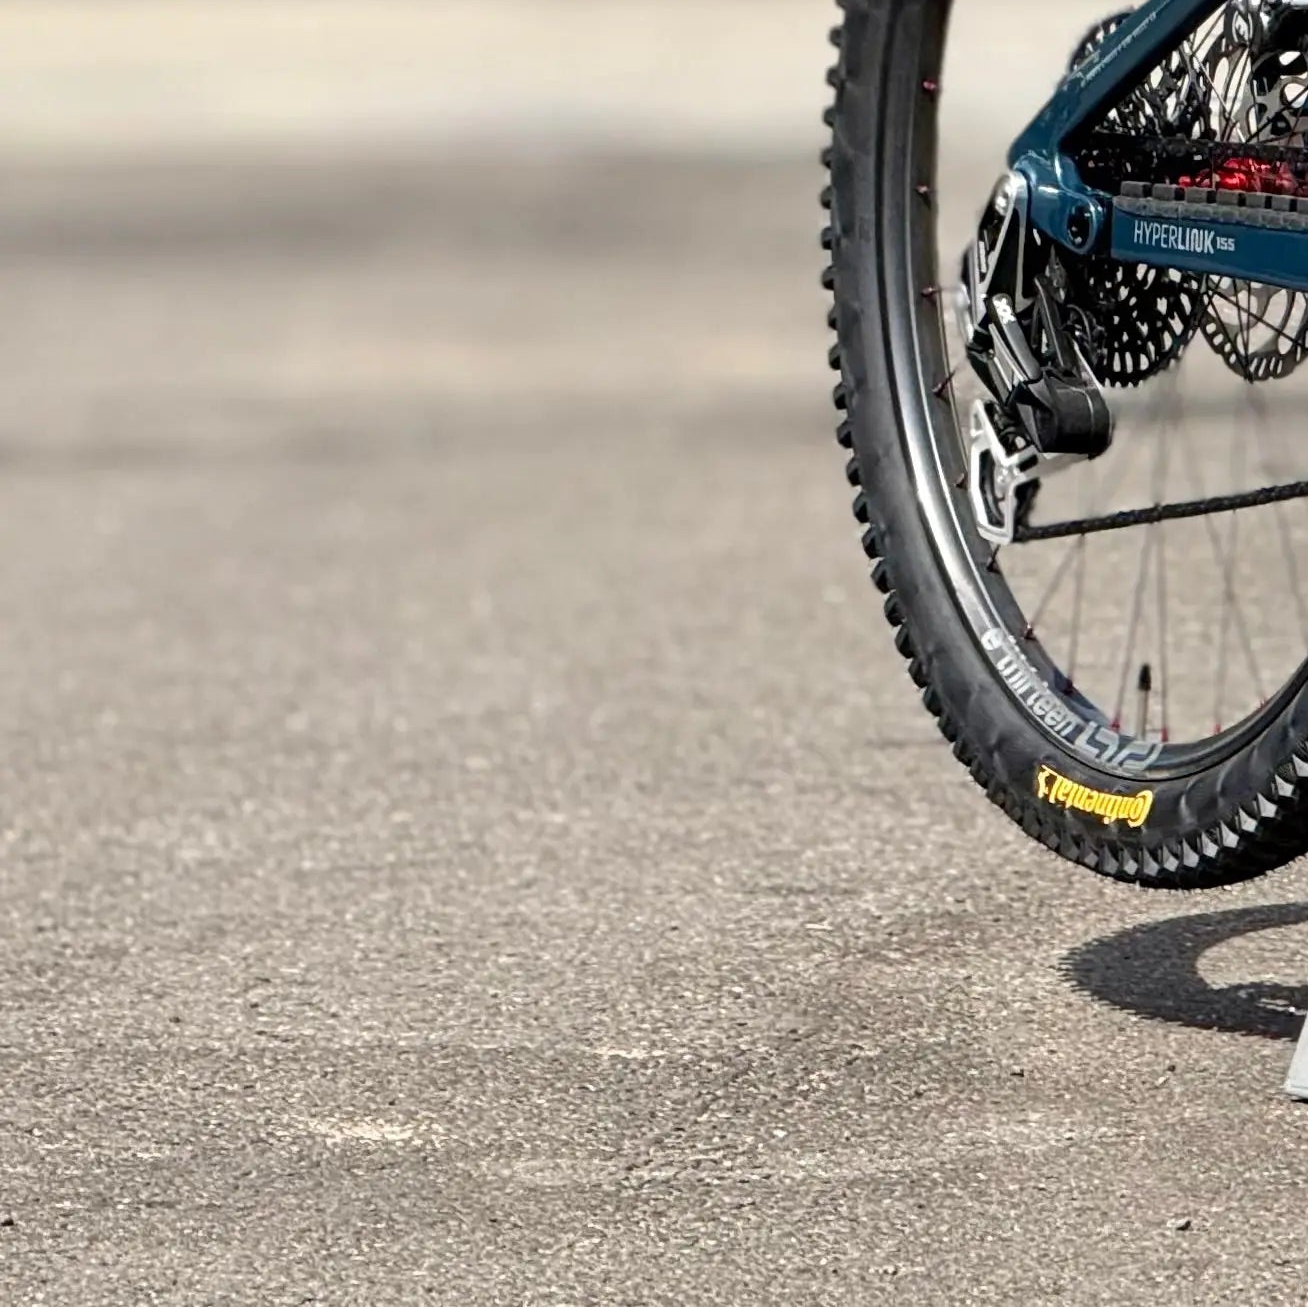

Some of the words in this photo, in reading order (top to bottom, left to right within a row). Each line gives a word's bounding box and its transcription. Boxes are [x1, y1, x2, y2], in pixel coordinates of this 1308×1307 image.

[1133, 219, 1215, 254] HYPERLINK
[1216, 236, 1236, 251] 155
[1048, 768, 1154, 828] Continental
